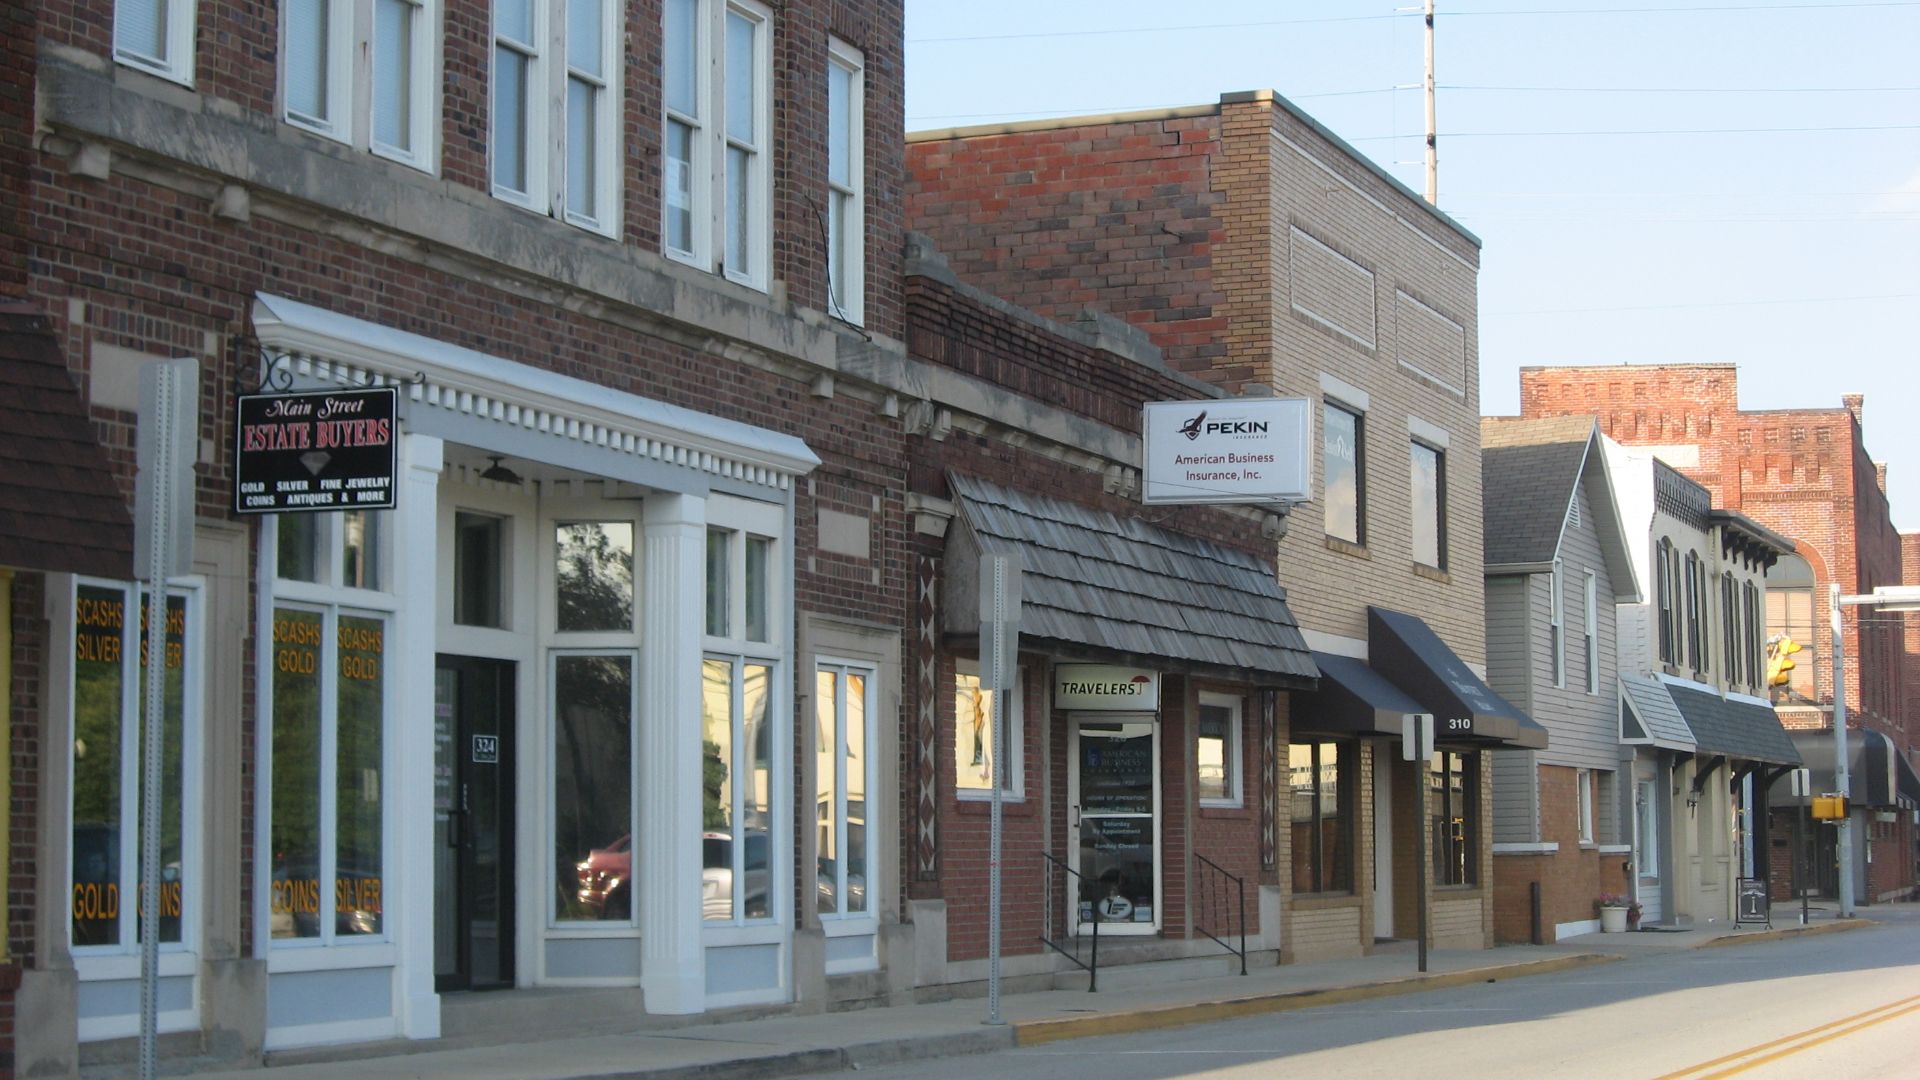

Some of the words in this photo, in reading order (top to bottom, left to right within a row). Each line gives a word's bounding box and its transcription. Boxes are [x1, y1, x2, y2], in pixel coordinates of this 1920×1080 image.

[265, 399, 312, 417] Main
[317, 398, 365, 419] Street
[243, 422, 311, 451] ESTATE
[316, 418, 390, 448] BUYERS
[1207, 421, 1268, 435] PEKIN
[1175, 454, 1225, 465] American
[1228, 453, 1274, 464] Business
[1186, 470, 1240, 481] Insurance,
[1243, 469, 1262, 480] Inc.
[241, 482, 265, 493] GOLD
[276, 480, 309, 492] SILVER
[320, 479, 342, 490] FINE
[345, 477, 390, 489] JEWELRY
[246, 495, 275, 507] COINS
[287, 493, 333, 506] ANTIQUES
[357, 491, 385, 502] MORE
[78, 633, 120, 662] SILVER
[279, 649, 314, 673] GOLD
[343, 655, 377, 679] GOLD
[1062, 683, 1135, 695] TRAVELERS
[1449, 719, 1470, 729] 310
[477, 738, 494, 752] 324
[74, 883, 118, 919] GOLD
[272, 879, 319, 912] COINS
[336, 878, 381, 912] SILVER
